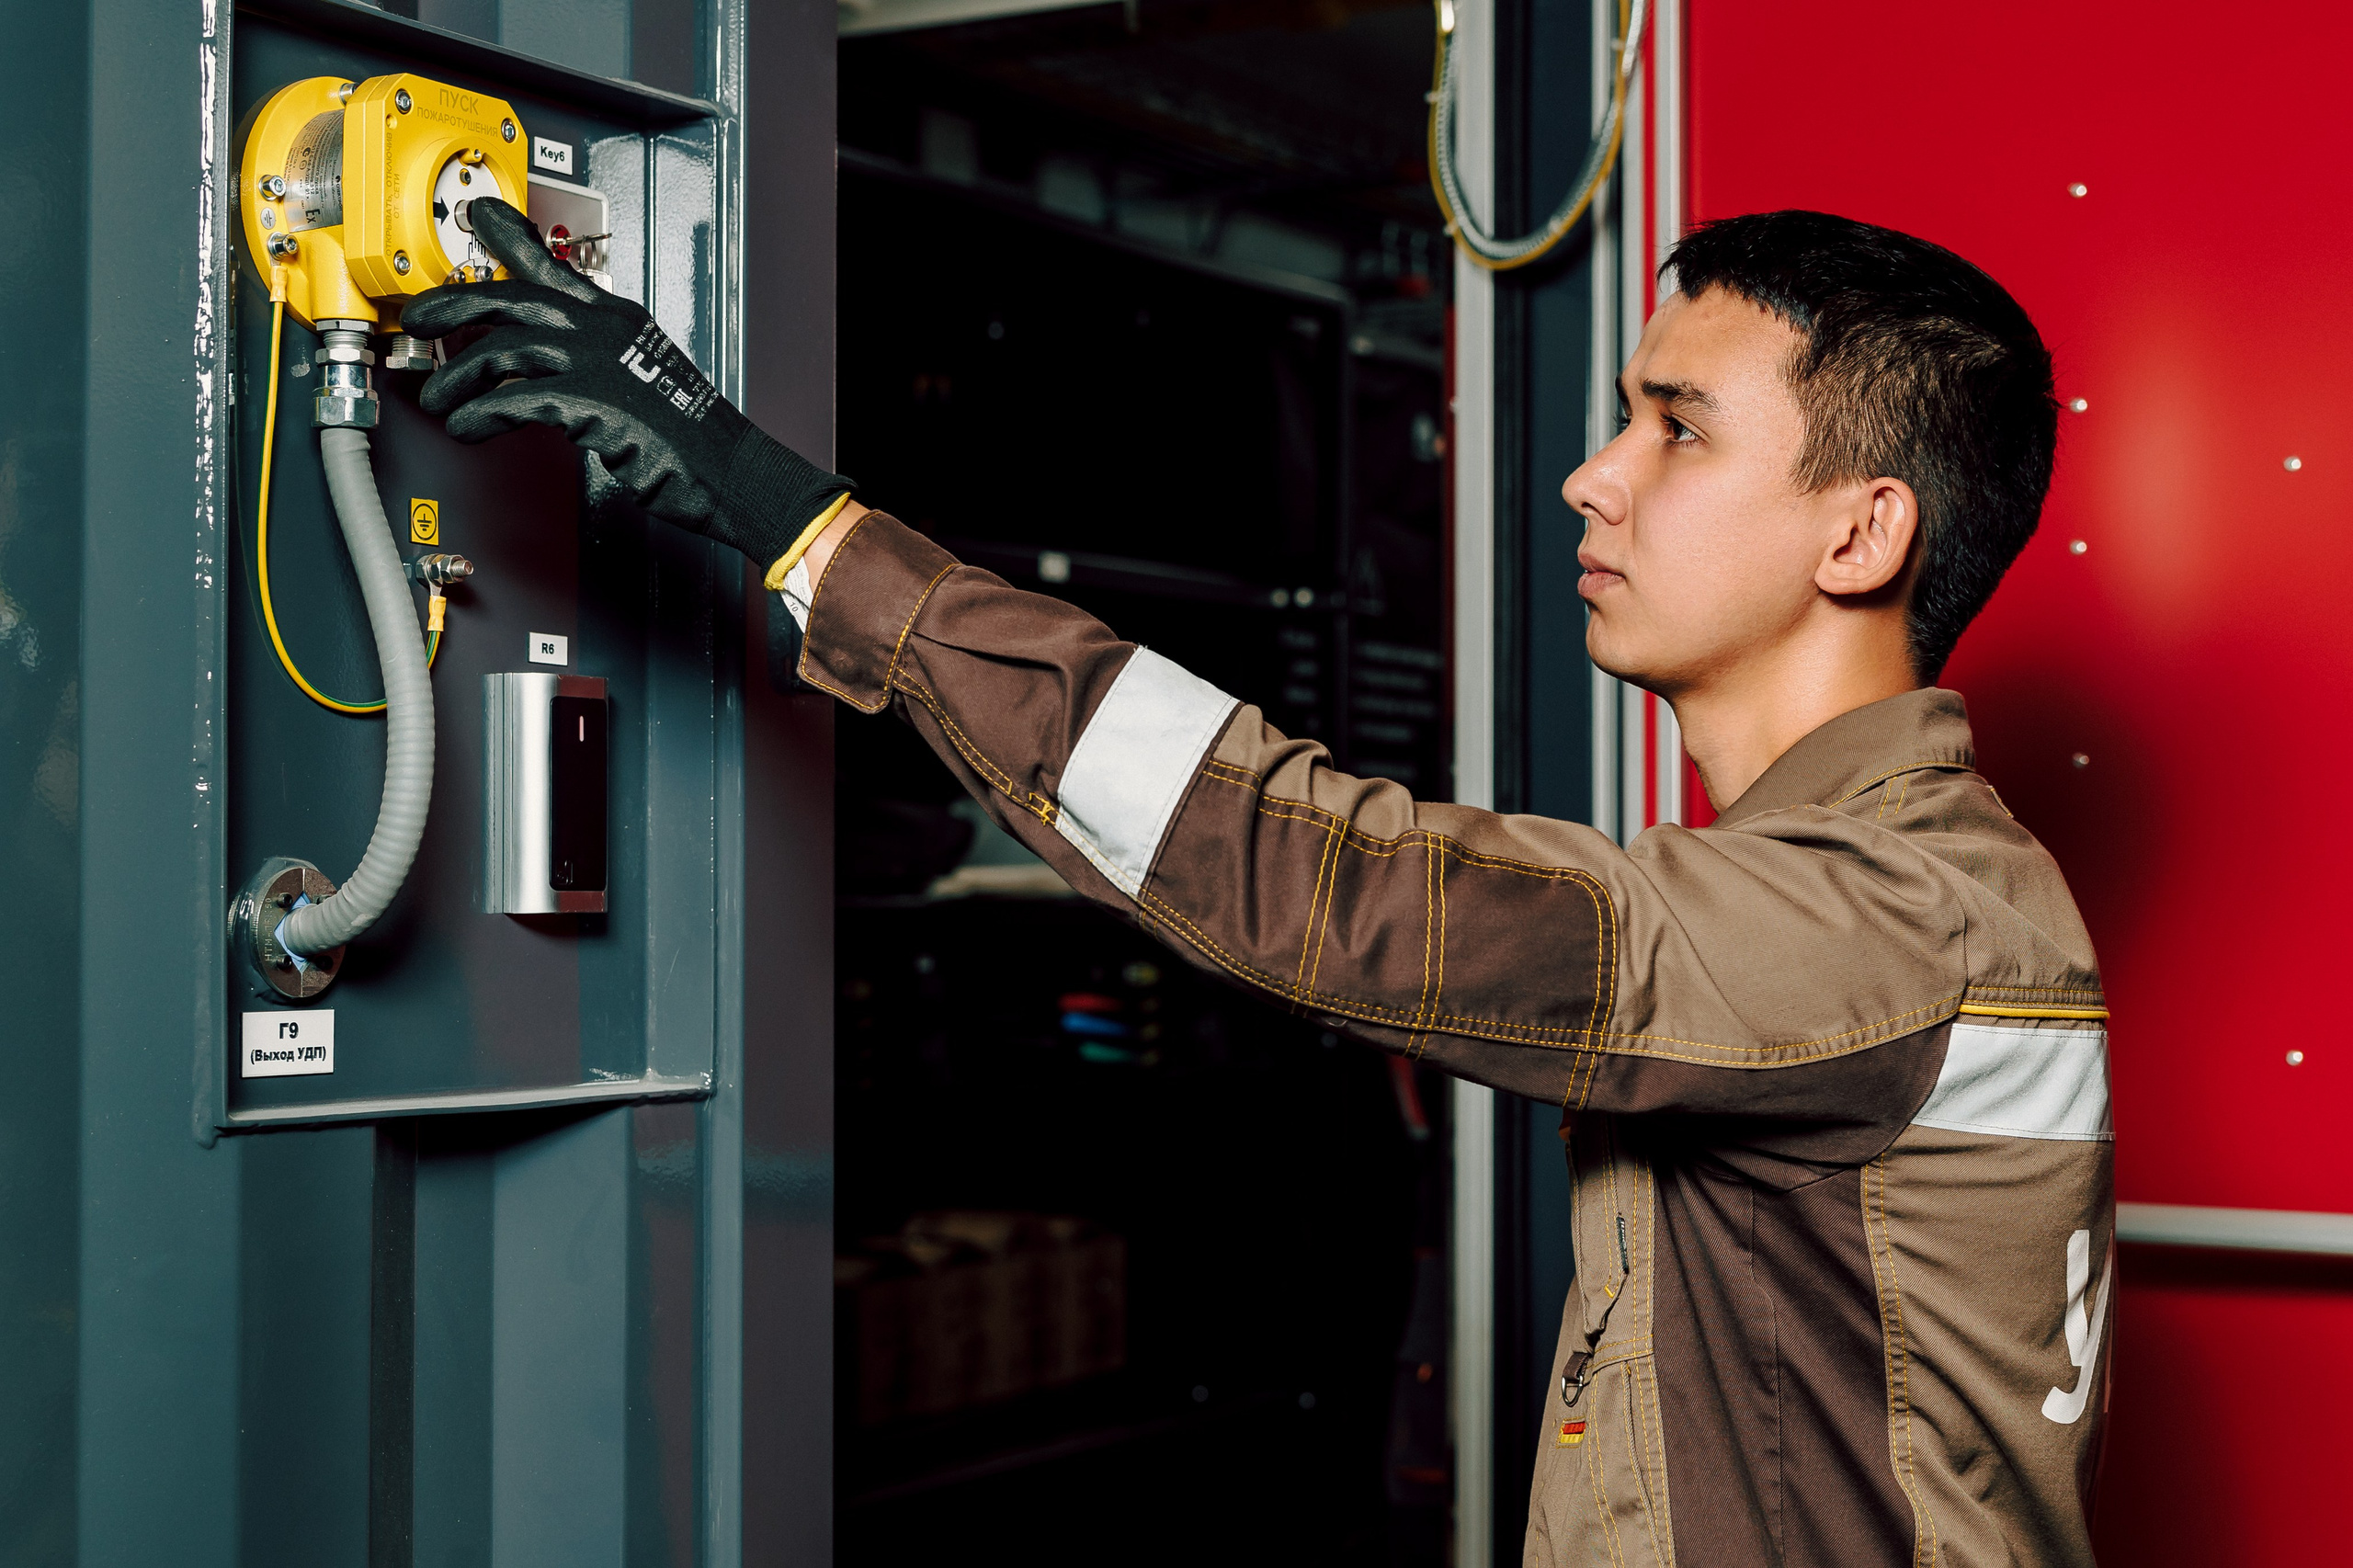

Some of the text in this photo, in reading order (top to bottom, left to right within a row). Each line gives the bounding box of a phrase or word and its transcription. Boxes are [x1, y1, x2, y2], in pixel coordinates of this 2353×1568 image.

[439, 88, 479, 115] ПУСК
[417, 107, 498, 138] ПОЖАРОТУШЕНИЯ
[540, 145, 565, 163] Key6
[305, 209, 321, 223] Ex
[541, 642, 555, 654] R6
[278, 1022, 299, 1040] Г9
[250, 1046, 326, 1065] (Выход УДП)
